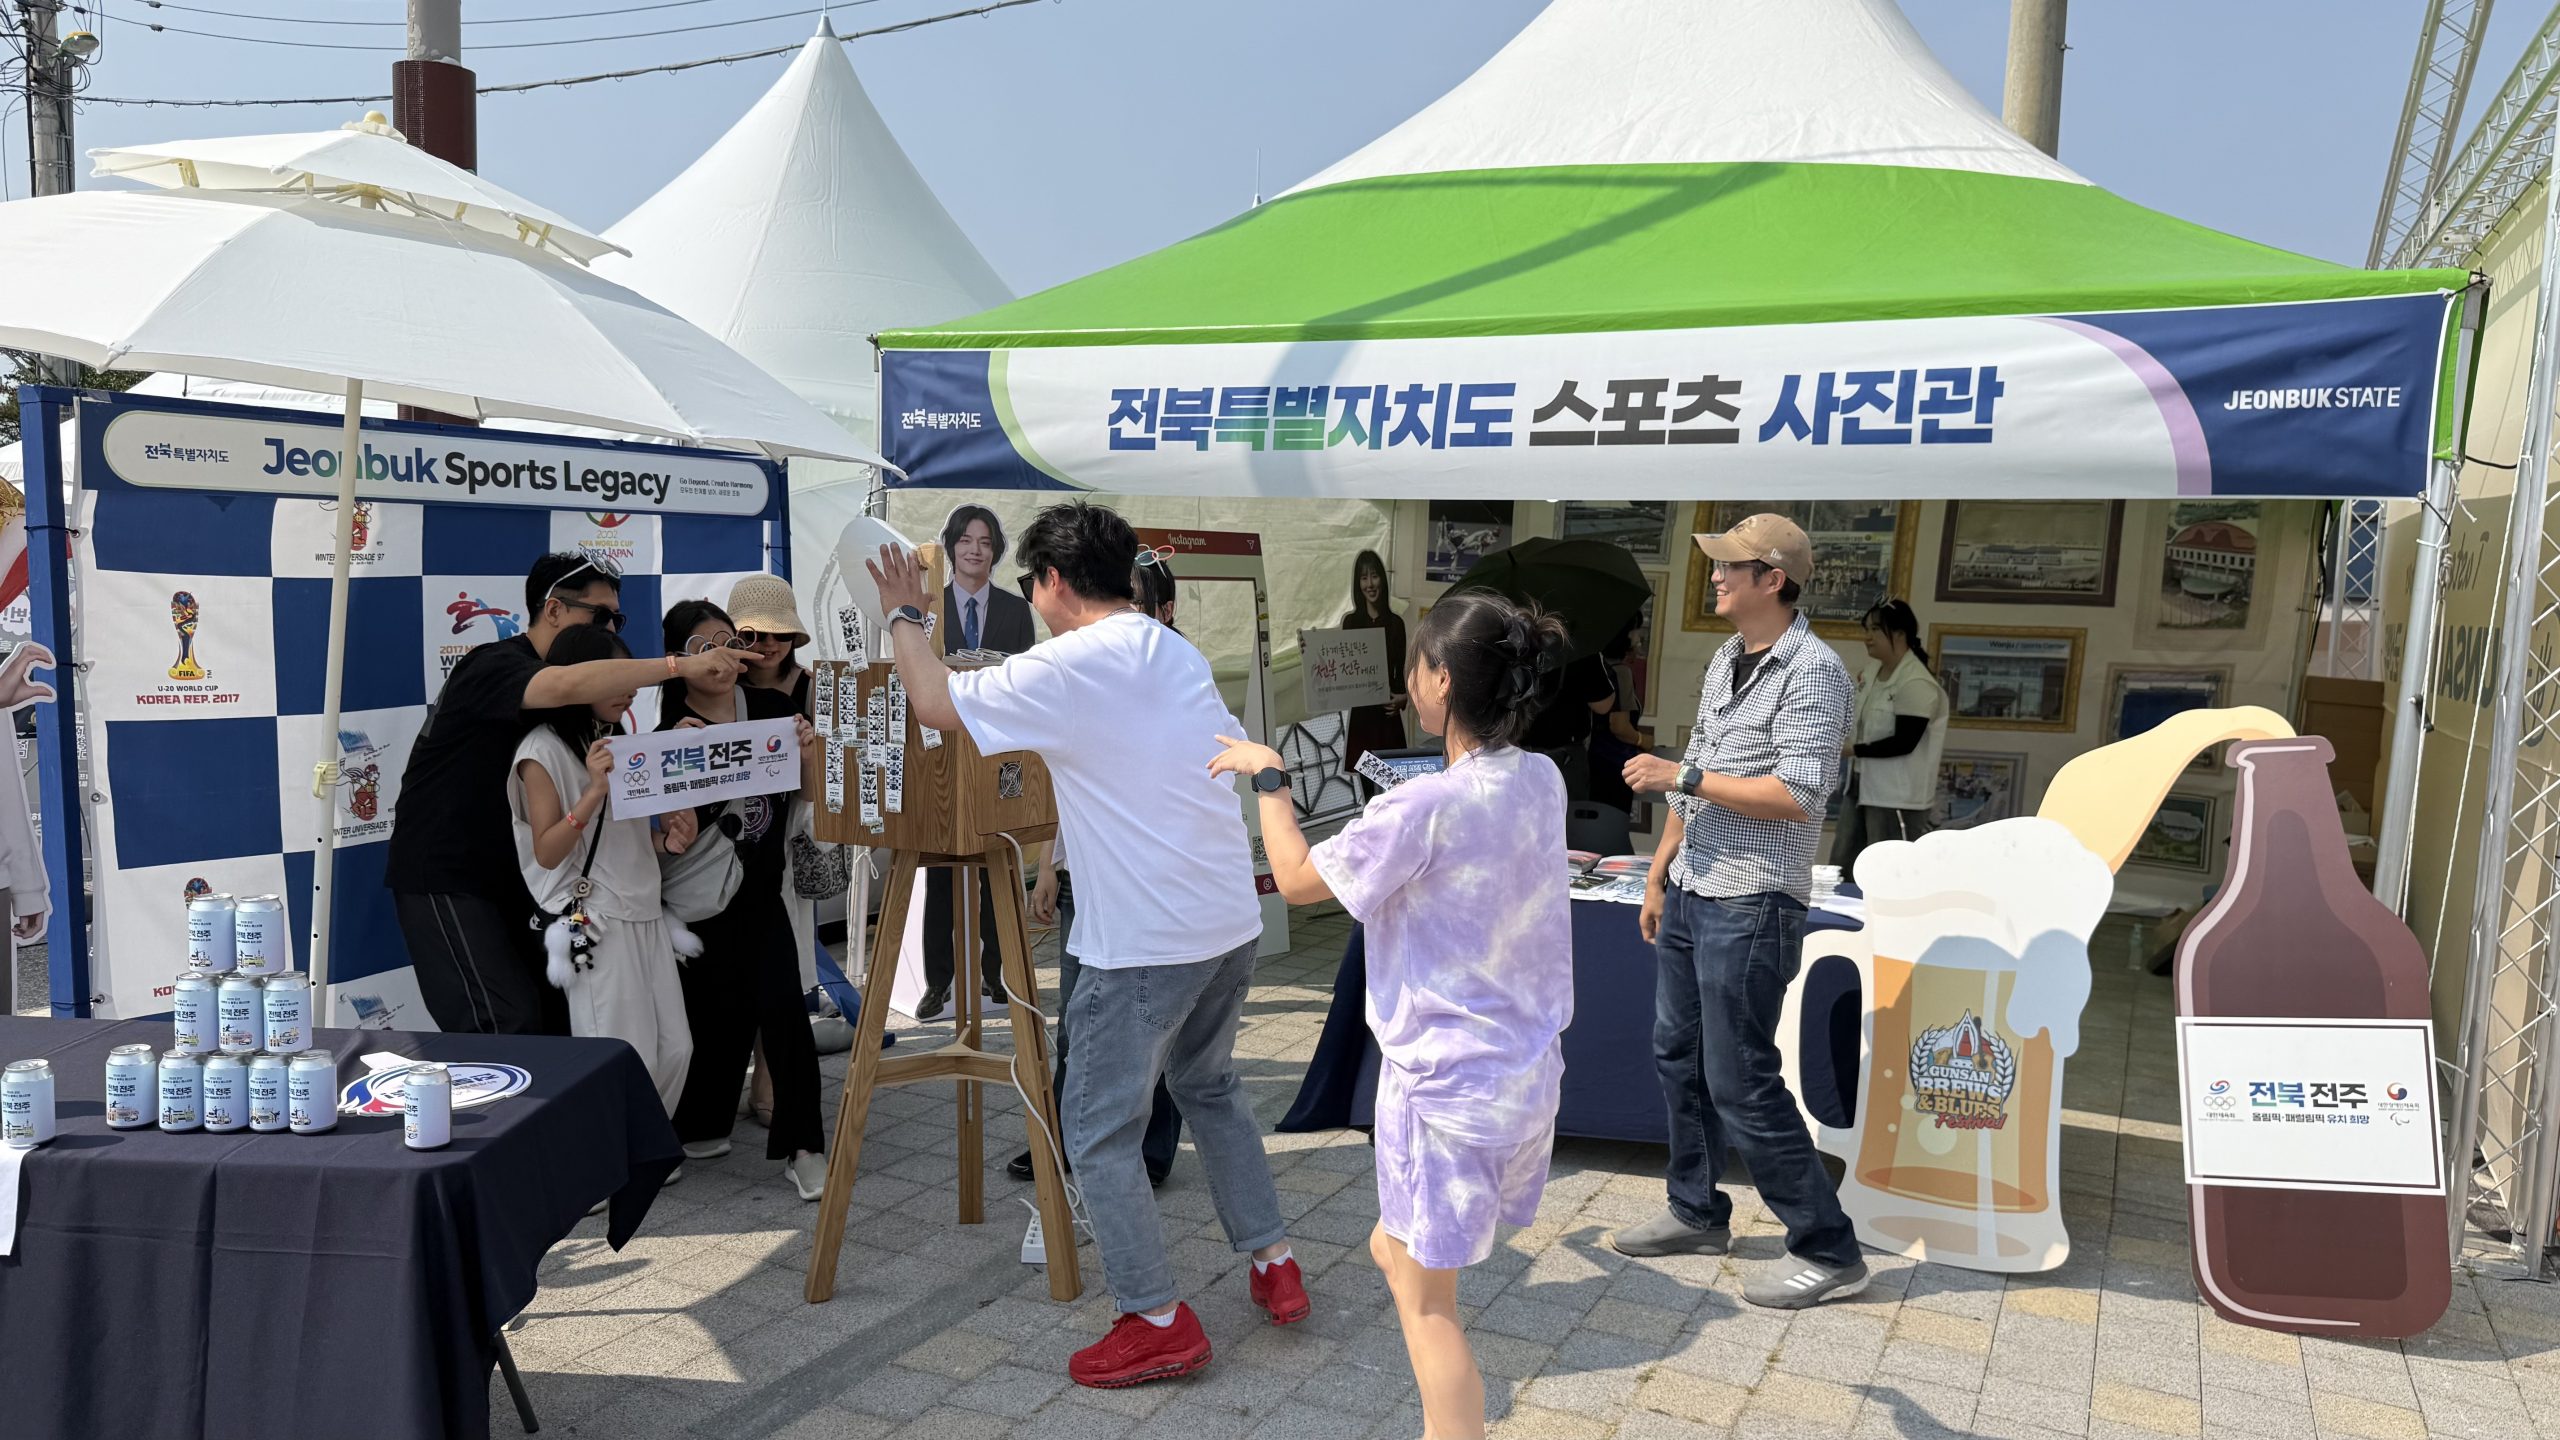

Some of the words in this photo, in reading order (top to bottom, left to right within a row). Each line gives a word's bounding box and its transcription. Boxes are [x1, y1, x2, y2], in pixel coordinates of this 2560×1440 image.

[1108, 382, 1516, 451] 전북특별자치도
[1529, 374, 1741, 448] 스포츠
[1758, 365, 2004, 445] 사진관
[263, 438, 439, 484] Jeobuk
[445, 452, 557, 494] Sports
[564, 461, 671, 504] Legacy
[1168, 533, 1206, 550] Instagram
[608, 547, 634, 559] JAPAN
[440, 645, 463, 655] 2017
[1989, 640, 2015, 650] Wanju
[136, 694, 181, 705] KOREA
[183, 694, 211, 704] REP.
[213, 693, 240, 703] 2017
[661, 745, 705, 778] 전북
[708, 739, 752, 771] 전주
[1928, 1065, 1991, 1083] GUNSAN
[1918, 1077, 2002, 1104] BREWS
[2249, 1082, 2305, 1107] 전북
[2310, 1083, 2368, 1109] 전주
[1935, 1113, 2008, 1130] Festival
[2252, 1112, 2325, 1123] 올림픽·패럴림픽
[2327, 1114, 2347, 1124] 유치
[2349, 1114, 2370, 1124] 희망
